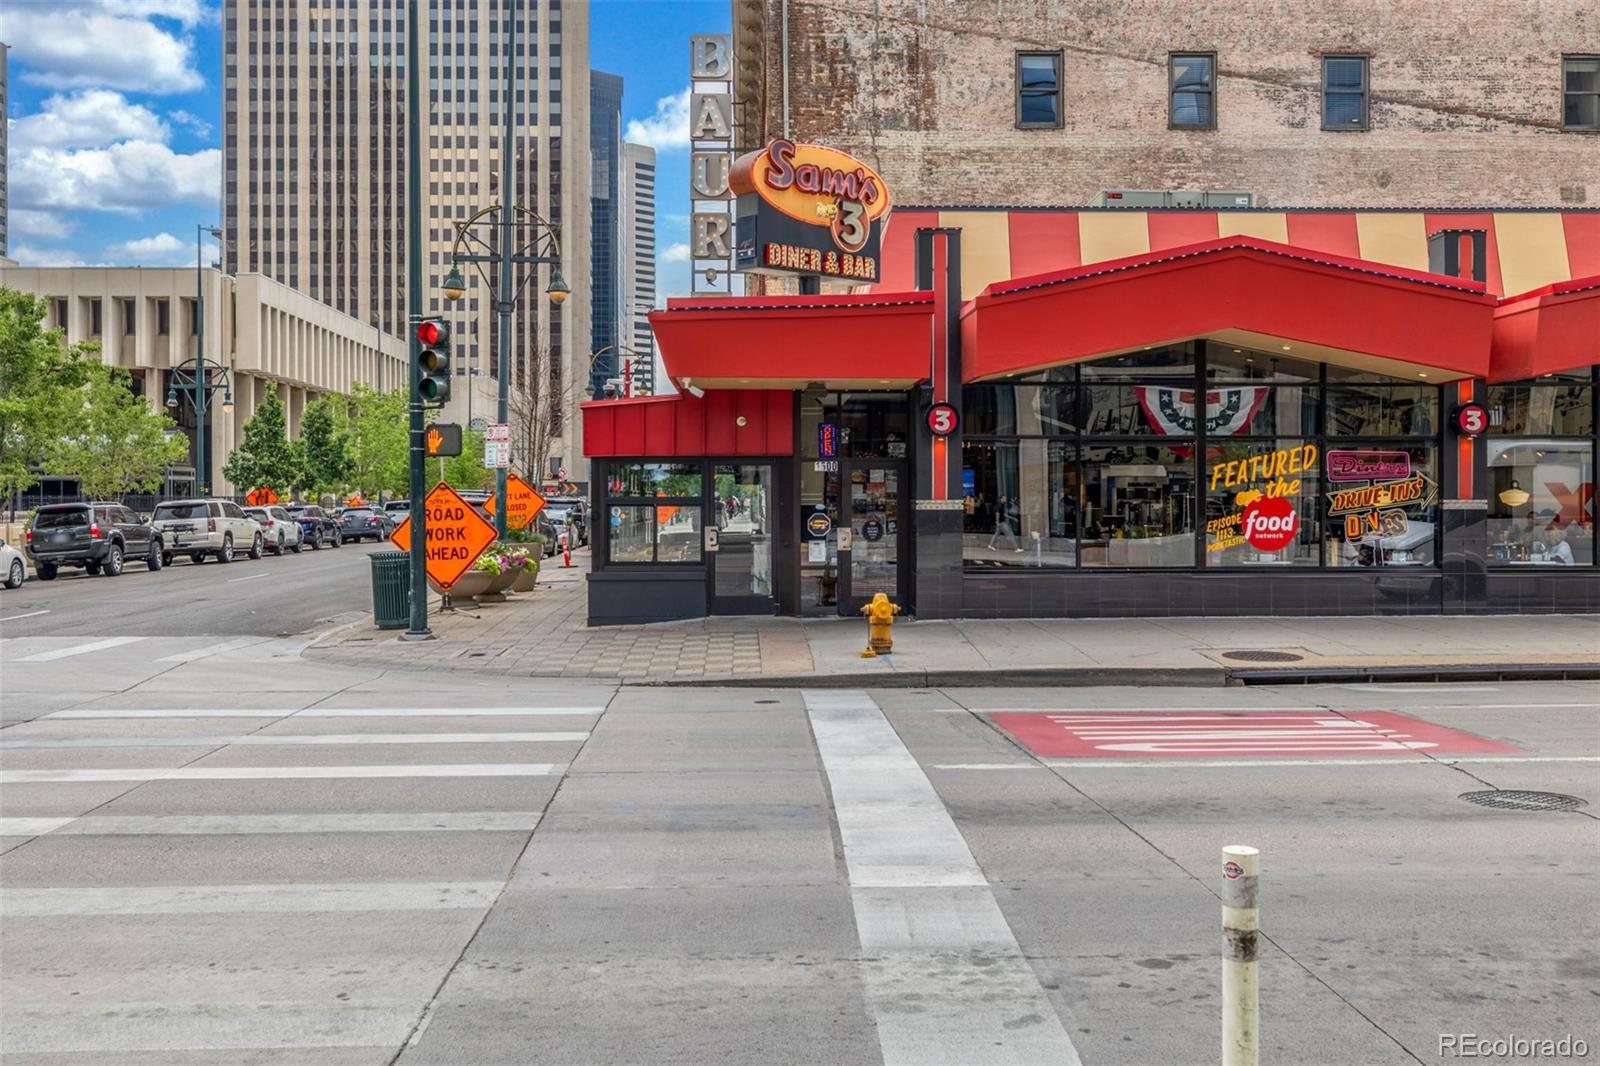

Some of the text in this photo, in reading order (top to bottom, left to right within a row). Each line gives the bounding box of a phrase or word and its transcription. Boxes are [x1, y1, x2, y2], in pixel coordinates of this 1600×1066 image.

[765, 138, 879, 204] Sam's
[839, 201, 865, 245] 3
[765, 243, 821, 271] DINER
[824, 251, 840, 275] &
[841, 254, 875, 279] BAR
[935, 409, 950, 431] 3
[1465, 410, 1481, 431] 3
[1211, 444, 1318, 491] FEATURED
[514, 492, 531, 500] LANE
[1235, 476, 1301, 507] on the
[425, 508, 464, 521] ROAD
[1207, 513, 1242, 532] EPISODE
[1245, 509, 1297, 540] food
[1346, 511, 1405, 539] DIVES
